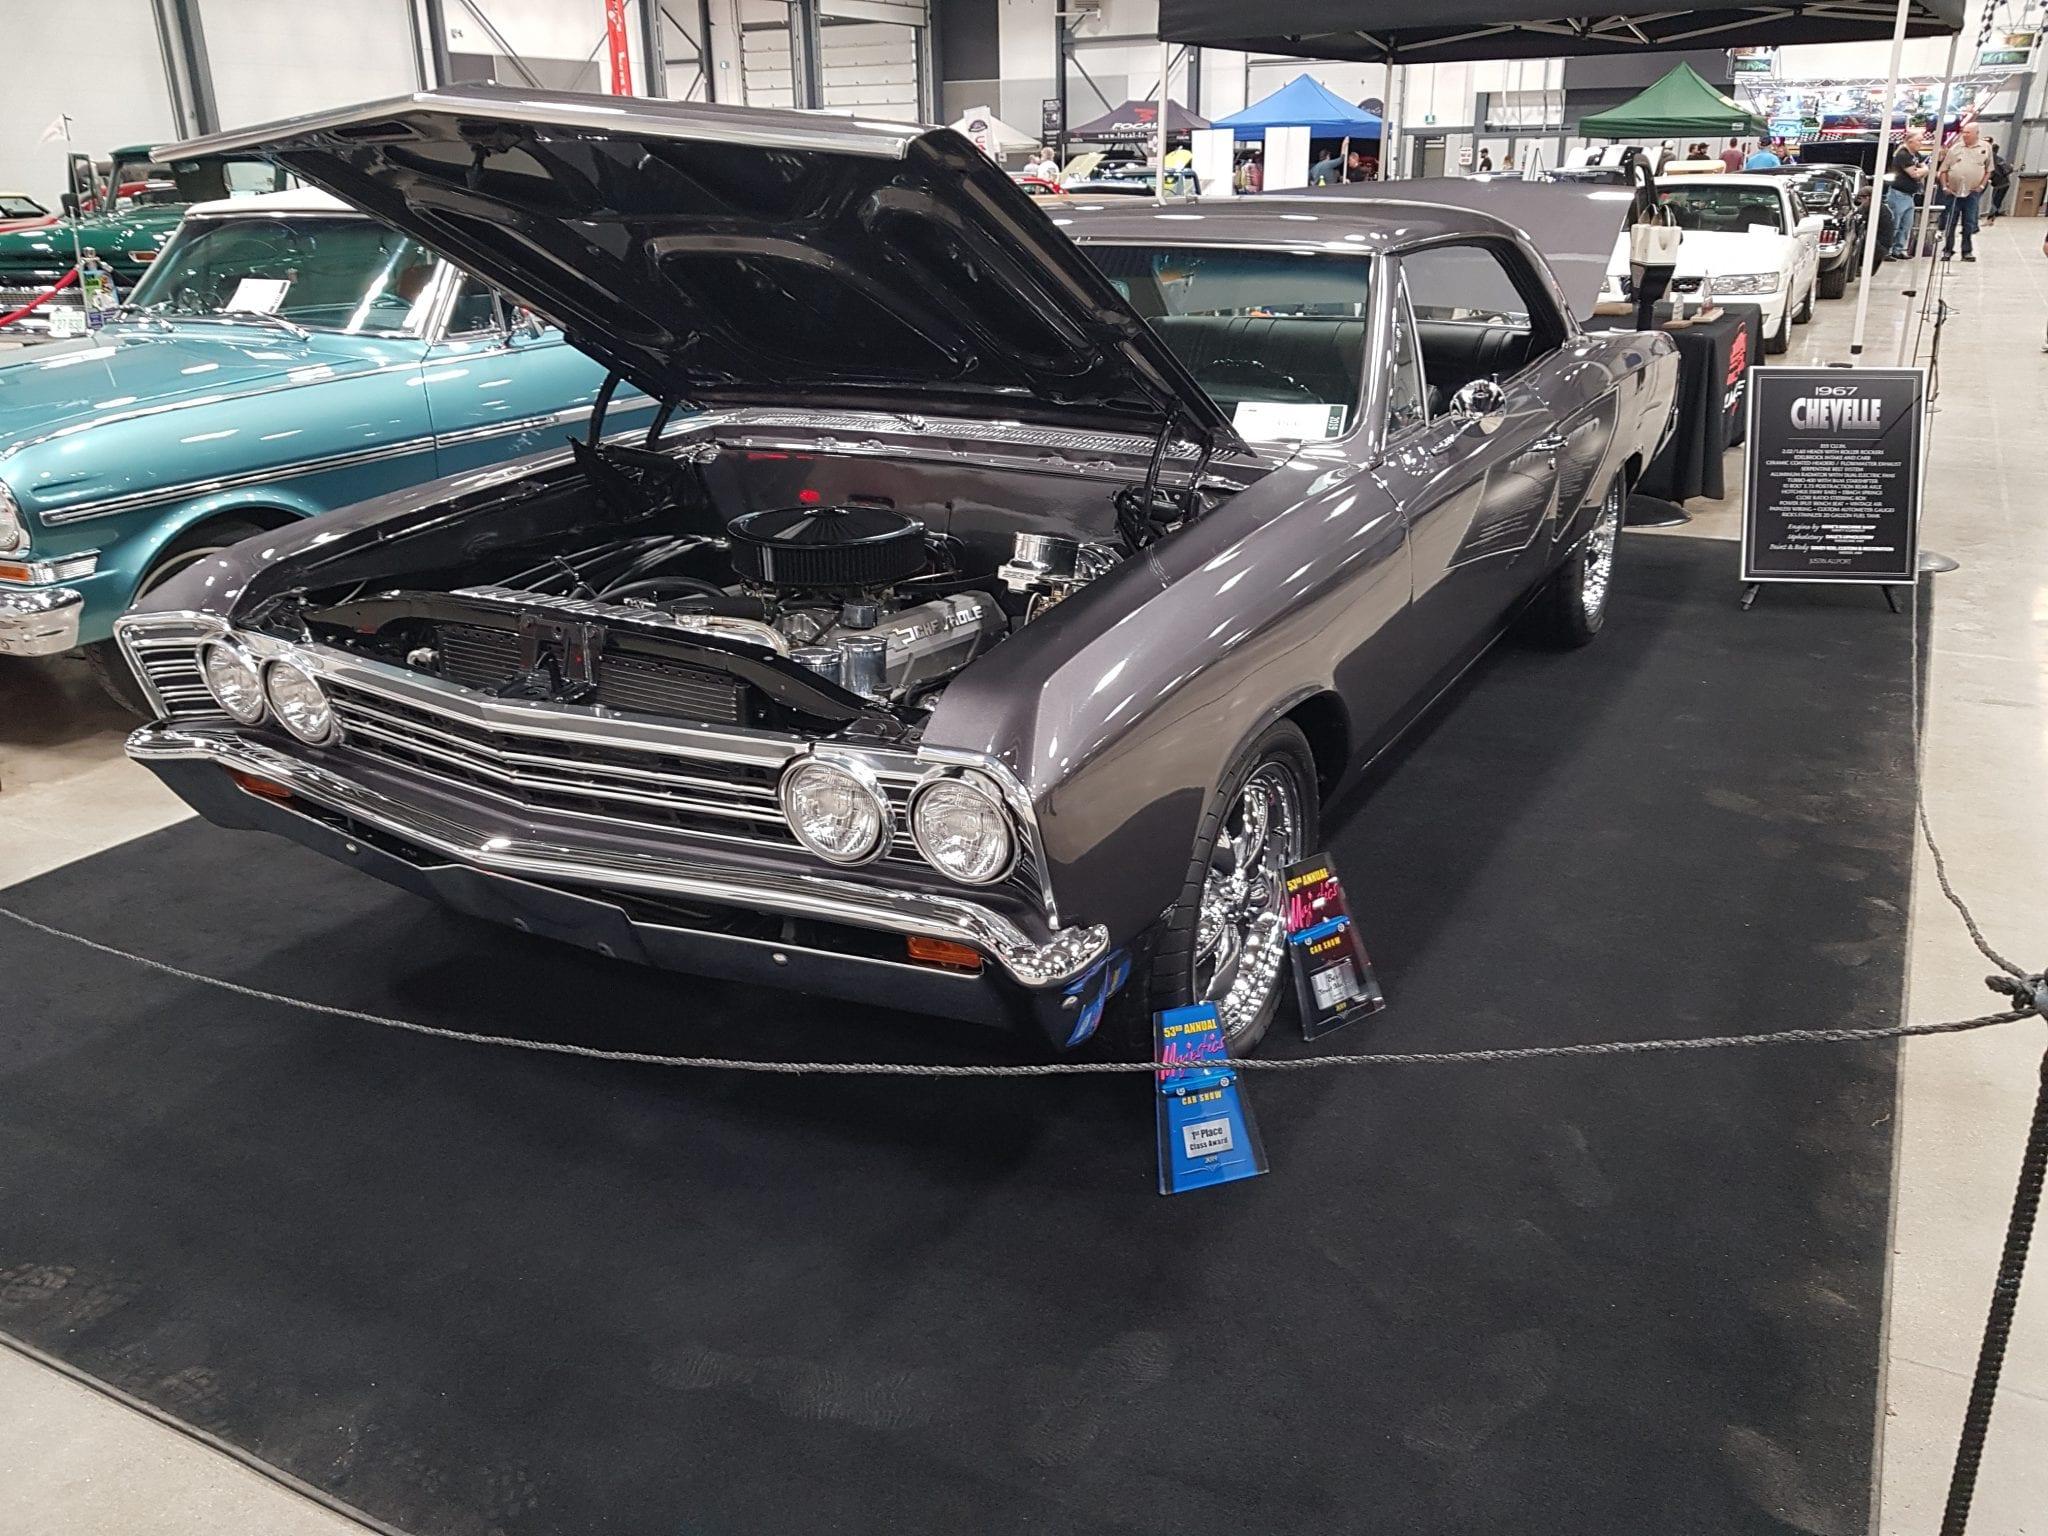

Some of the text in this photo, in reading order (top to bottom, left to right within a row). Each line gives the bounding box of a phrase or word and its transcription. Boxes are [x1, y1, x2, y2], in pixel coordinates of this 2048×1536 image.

[1112, 122, 1158, 131] FOCAL
[1815, 386, 1858, 396] 1967
[1790, 397, 1882, 433] CHEVELLE
[914, 605, 985, 639] CHEVROLE
[1302, 867, 1329, 886] ANNUAL
[1309, 936, 1342, 955] CAR SHOW
[1163, 1019, 1217, 1038] 53RD ANNUAL
[1181, 1090, 1222, 1106] CAR SHOW
[1200, 1127, 1223, 1139] Place
[1189, 1137, 1228, 1151] Class Award
